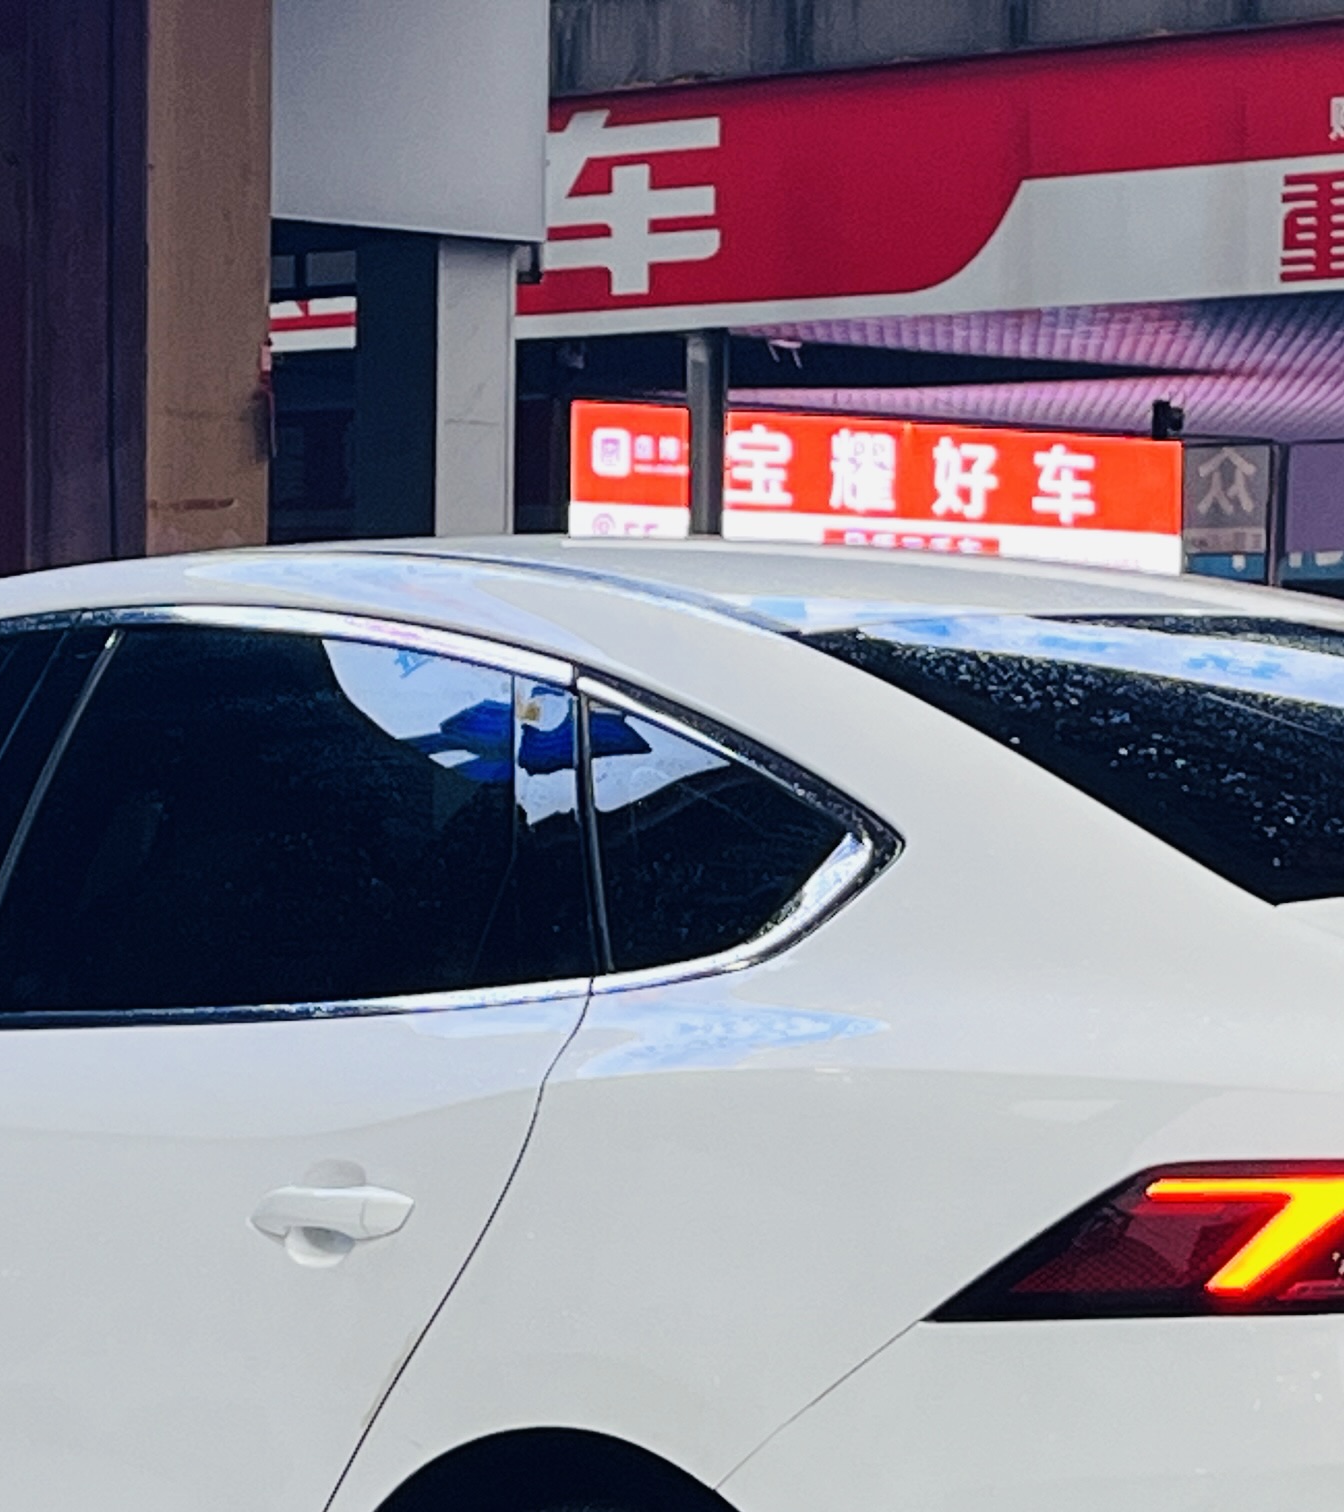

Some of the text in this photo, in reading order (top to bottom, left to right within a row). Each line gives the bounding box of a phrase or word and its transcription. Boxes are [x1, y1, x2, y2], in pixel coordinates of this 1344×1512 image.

[544, 109, 720, 296] 车
[725, 424, 1096, 525] 宝耀好车
